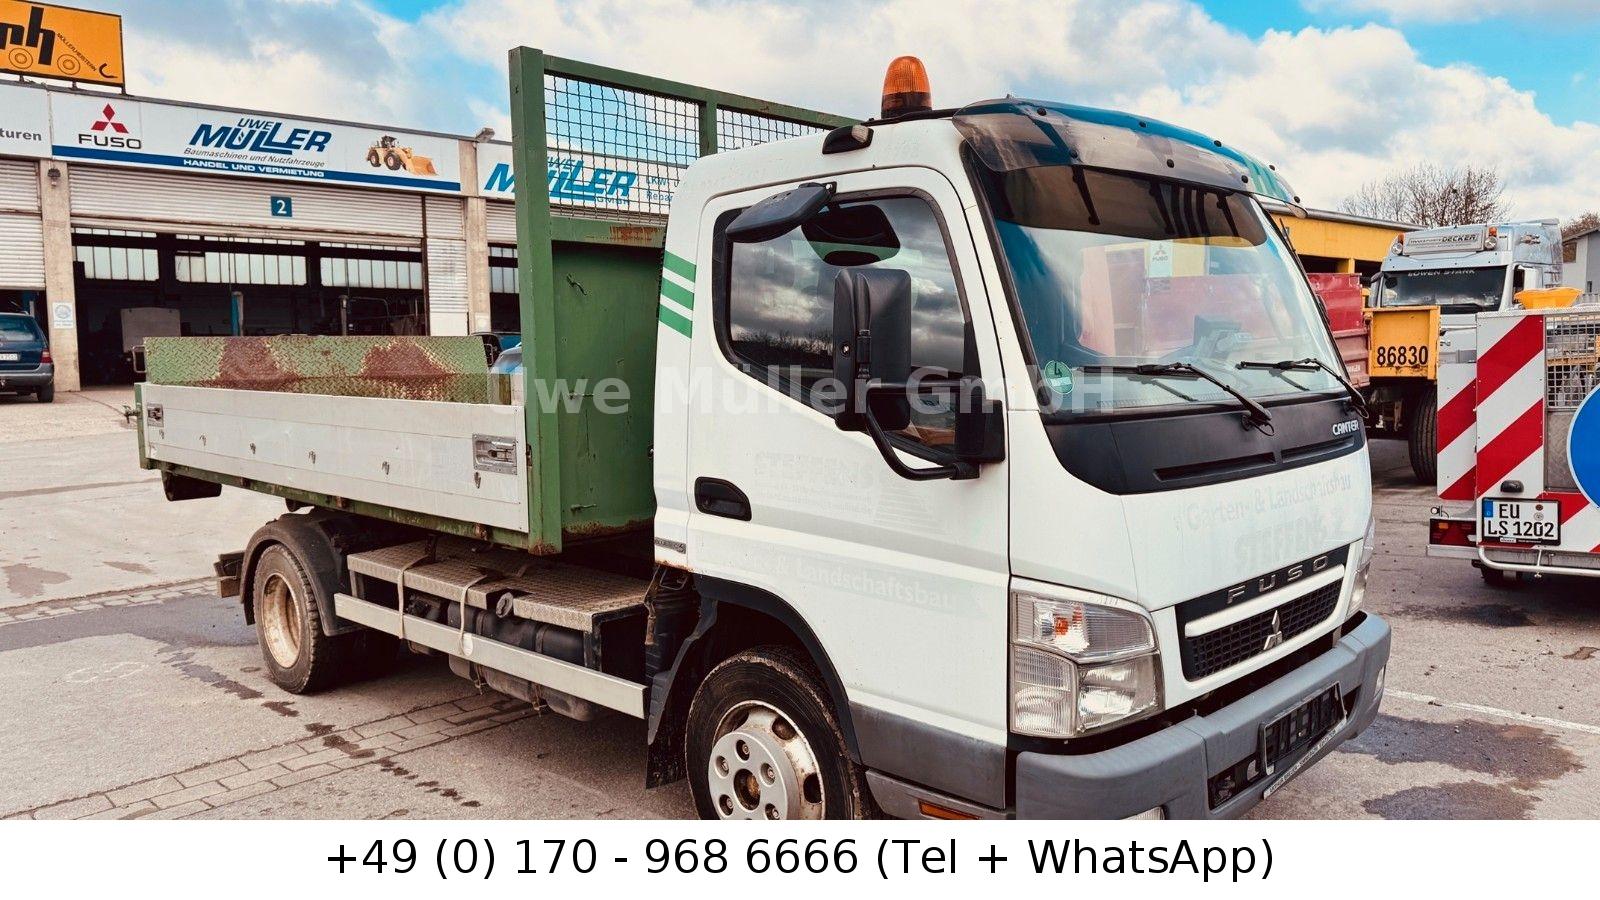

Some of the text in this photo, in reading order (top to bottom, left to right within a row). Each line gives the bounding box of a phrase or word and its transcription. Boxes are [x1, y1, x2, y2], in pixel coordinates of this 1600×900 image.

[237, 118, 274, 131] UWE
[78, 133, 142, 149] FUSO
[189, 122, 332, 155] MÜLLER
[184, 147, 326, 168] Baumaschinen und Nutzfahrzeuge
[184, 159, 325, 178] HANDEL UND VERMIETUNG
[276, 199, 288, 215] 2
[1377, 345, 1429, 366] 86830
[1332, 420, 1359, 436] CANTER
[1498, 504, 1520, 519] EU
[1488, 520, 1555, 537] LS 1202
[1226, 555, 1328, 605] FUSO
